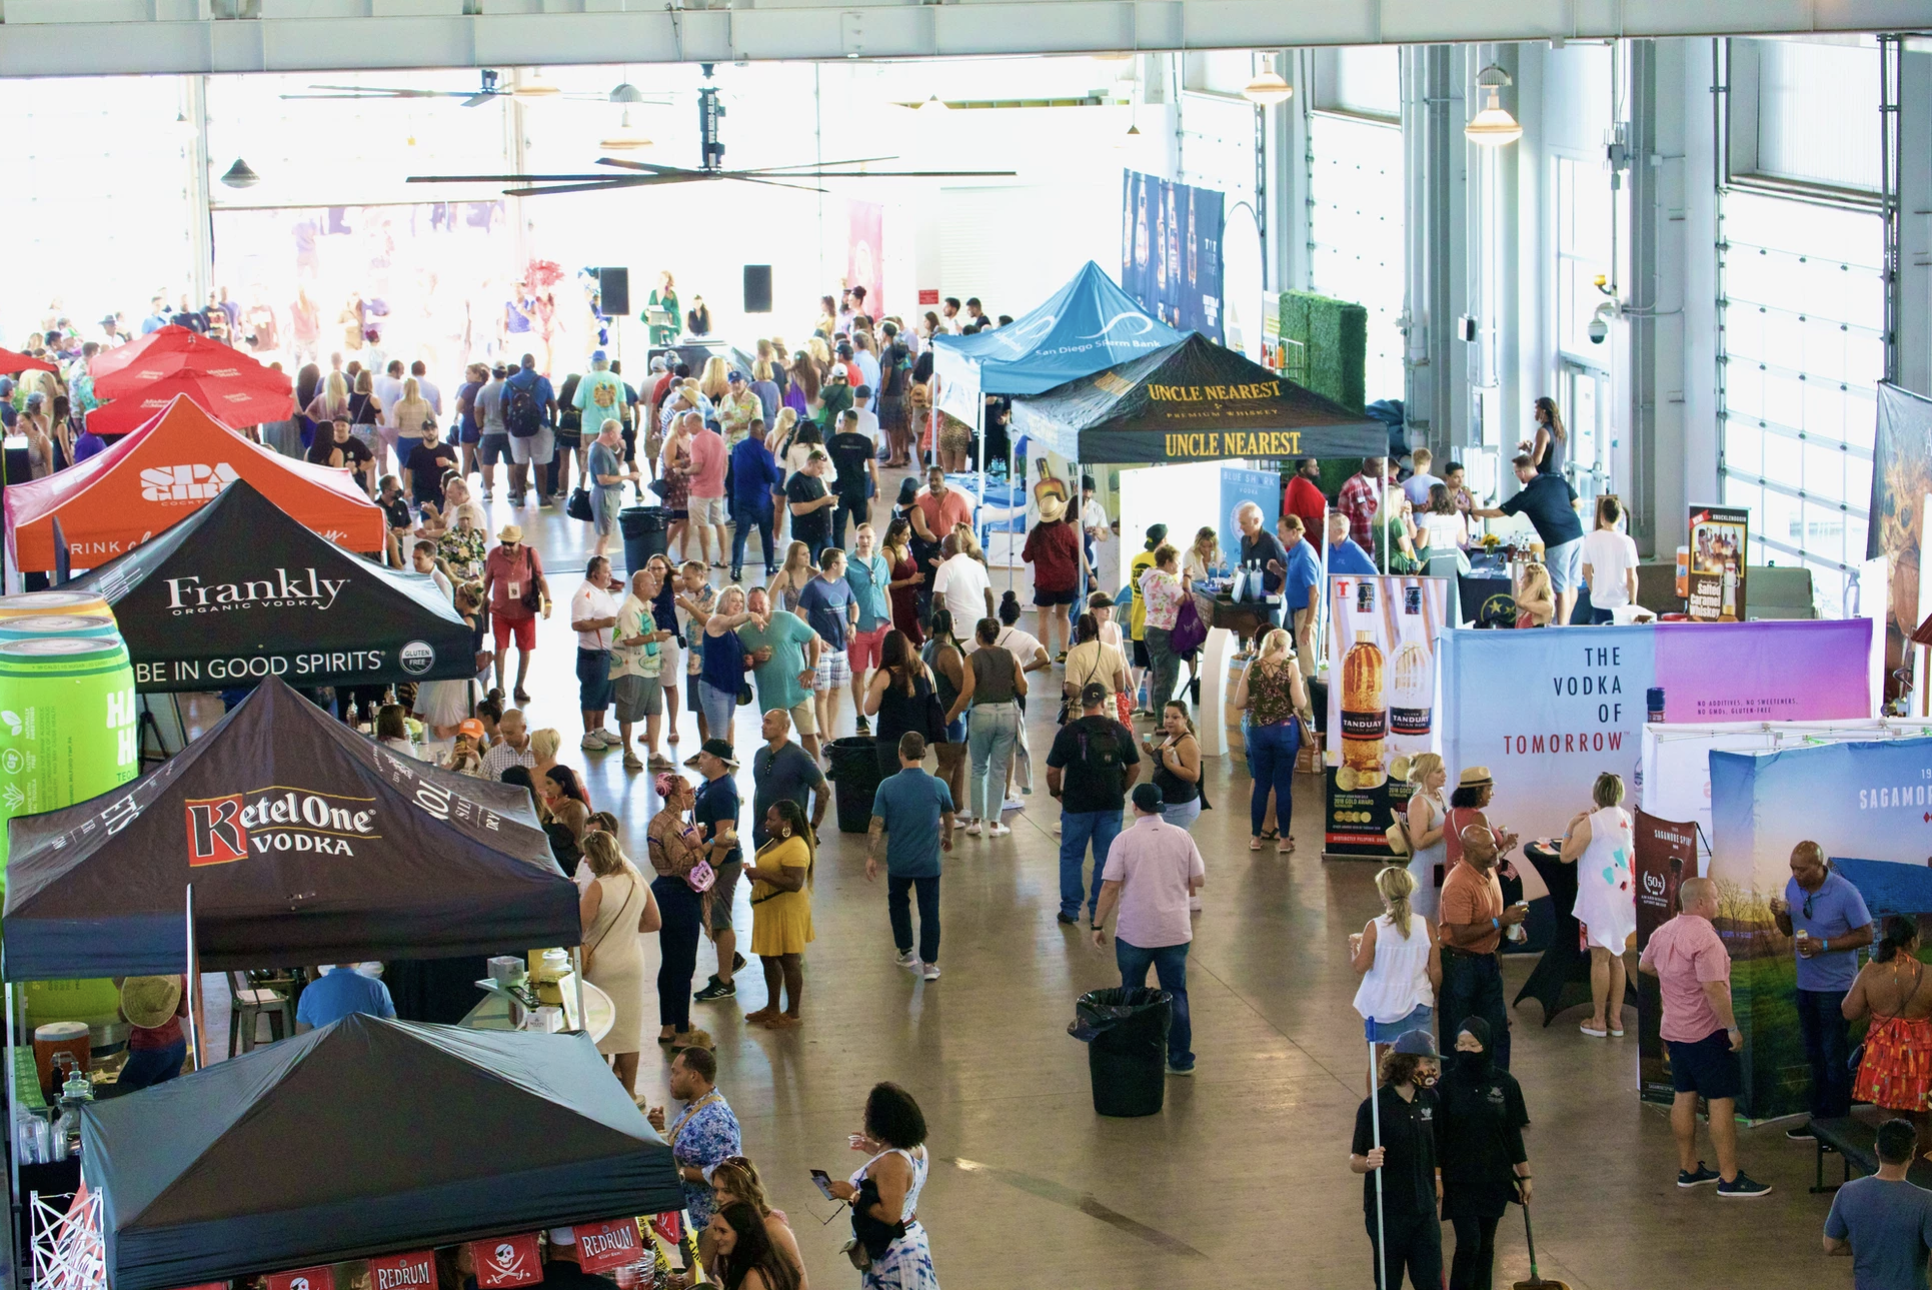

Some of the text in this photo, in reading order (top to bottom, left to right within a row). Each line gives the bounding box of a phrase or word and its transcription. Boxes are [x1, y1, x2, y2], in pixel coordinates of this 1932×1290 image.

[1058, 343, 1092, 354] Diego
[1132, 340, 1161, 348] Bank
[1148, 380, 1280, 402] UNCLE NEAREST
[1226, 409, 1278, 417] WHISKEY
[1165, 432, 1301, 457] UNCLE NEAREST
[140, 462, 240, 486] SPA
[1223, 471, 1242, 482] BLUE
[70, 541, 120, 554] RINK
[163, 567, 346, 610] Frankly
[1697, 582, 1722, 596] Salted
[172, 599, 320, 616] ORGANIC VODKA
[1690, 594, 1721, 607] Caramel
[1689, 604, 1720, 618] Whiskey
[404, 649, 430, 658] GLUTEN
[1584, 646, 1620, 667] THE
[136, 650, 382, 683] BE IN GOOD SPIRITS
[1554, 675, 1622, 696] VODKA
[1598, 703, 1622, 723] OF
[1343, 720, 1382, 728] TANDUAY
[188, 792, 300, 857] Ketel
[486, 812, 500, 831] DRY
[250, 833, 354, 856] VODKA
[1648, 876, 1662, 888] 50x
[581, 1226, 634, 1257] REDRUM
[378, 1262, 430, 1290] REDRUM
